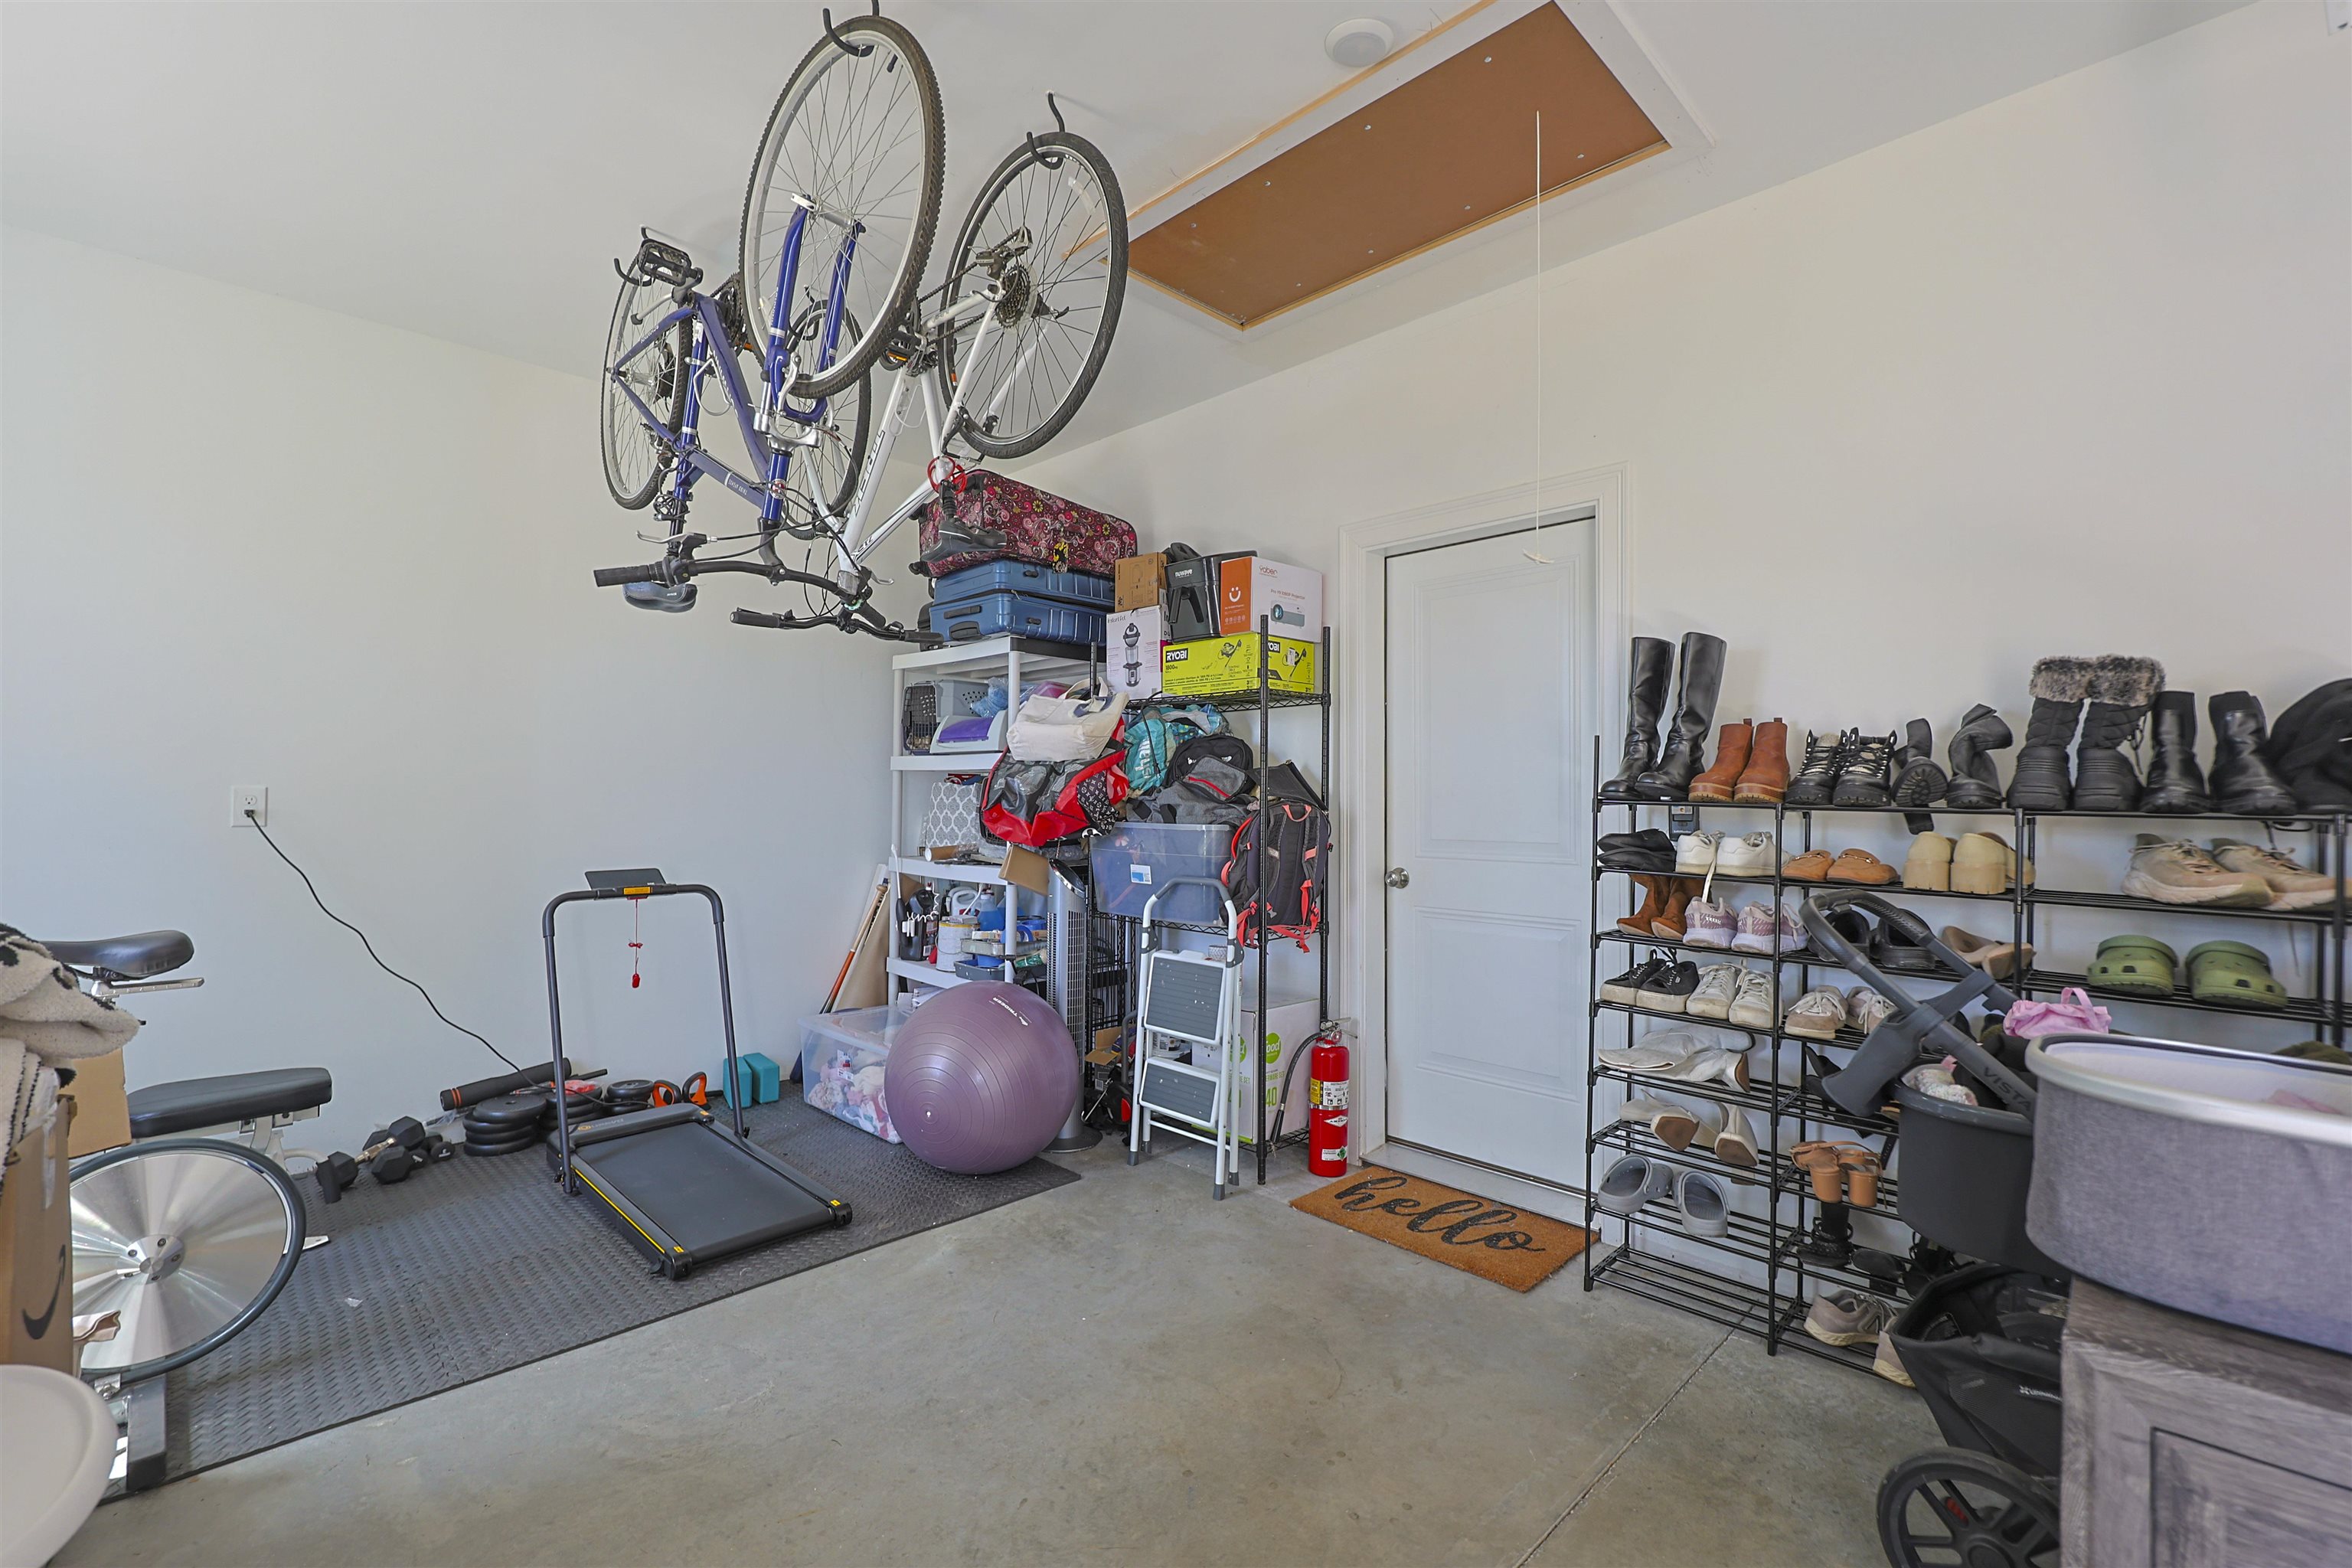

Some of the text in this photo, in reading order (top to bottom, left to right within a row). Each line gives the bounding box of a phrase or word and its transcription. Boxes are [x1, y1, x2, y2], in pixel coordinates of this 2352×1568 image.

[1268, 642, 1279, 652] OBI
[1166, 649, 1187, 662] RYOBI
[1334, 1176, 1546, 1251] hello
